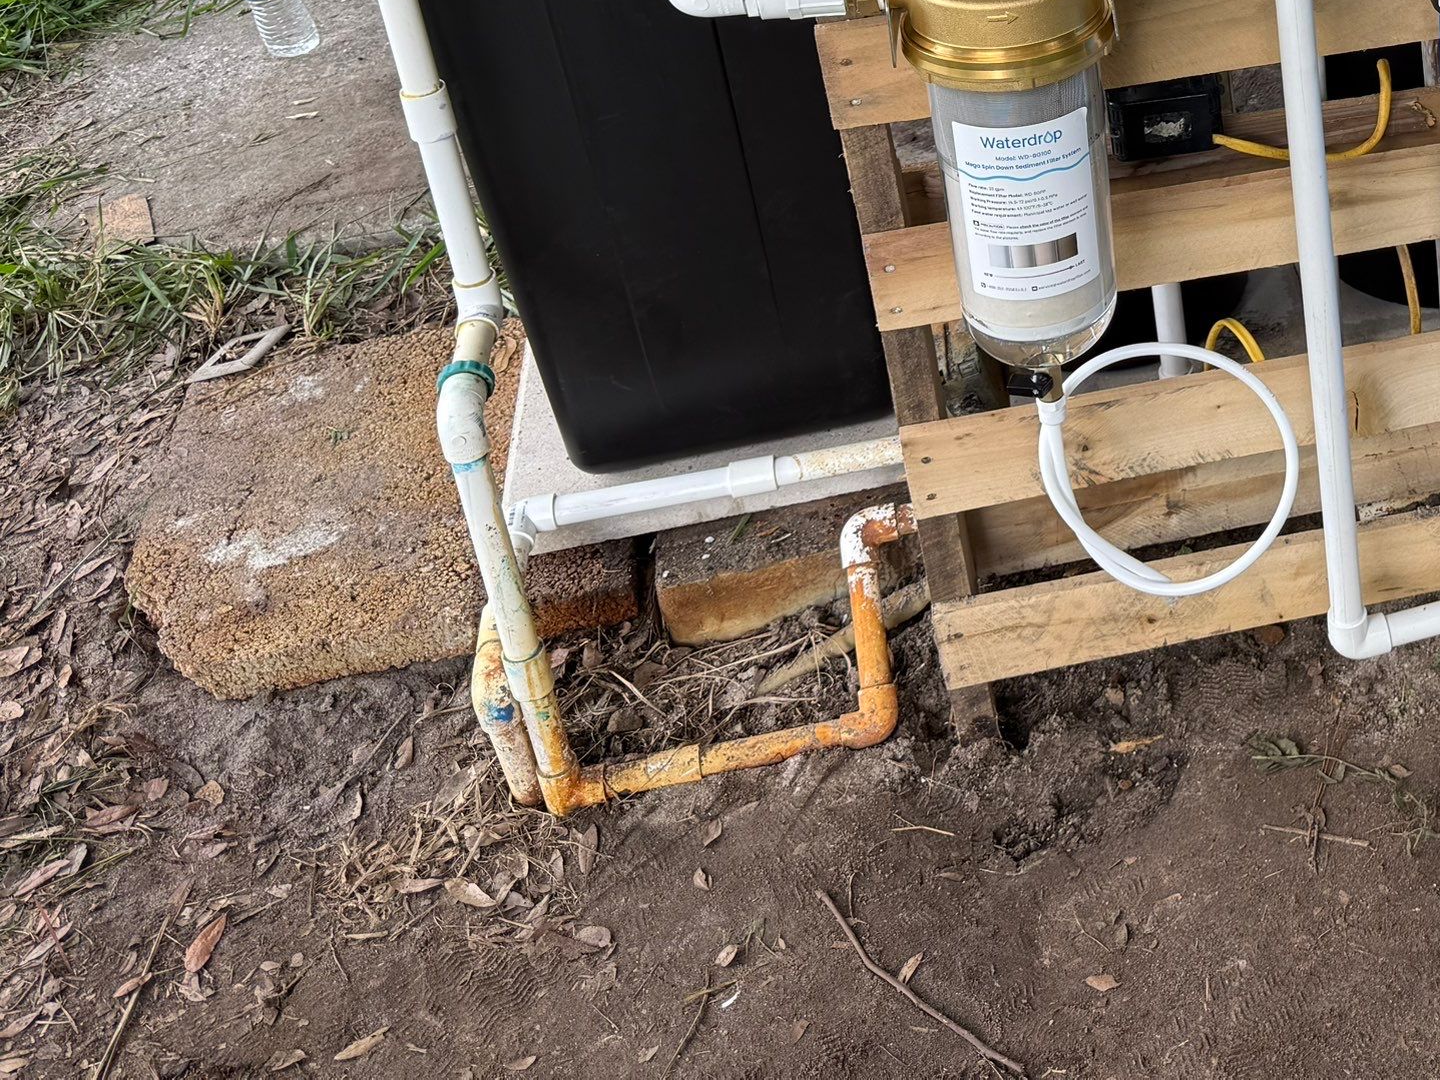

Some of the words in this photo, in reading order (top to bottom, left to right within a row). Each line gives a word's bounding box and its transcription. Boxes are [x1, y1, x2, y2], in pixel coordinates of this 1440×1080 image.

[980, 129, 1062, 149] Waterdrop
[965, 161, 980, 169] Mega
[1015, 160, 1046, 170] Sediment
[1047, 156, 1061, 164] Filter
[1062, 147, 1081, 160] System
